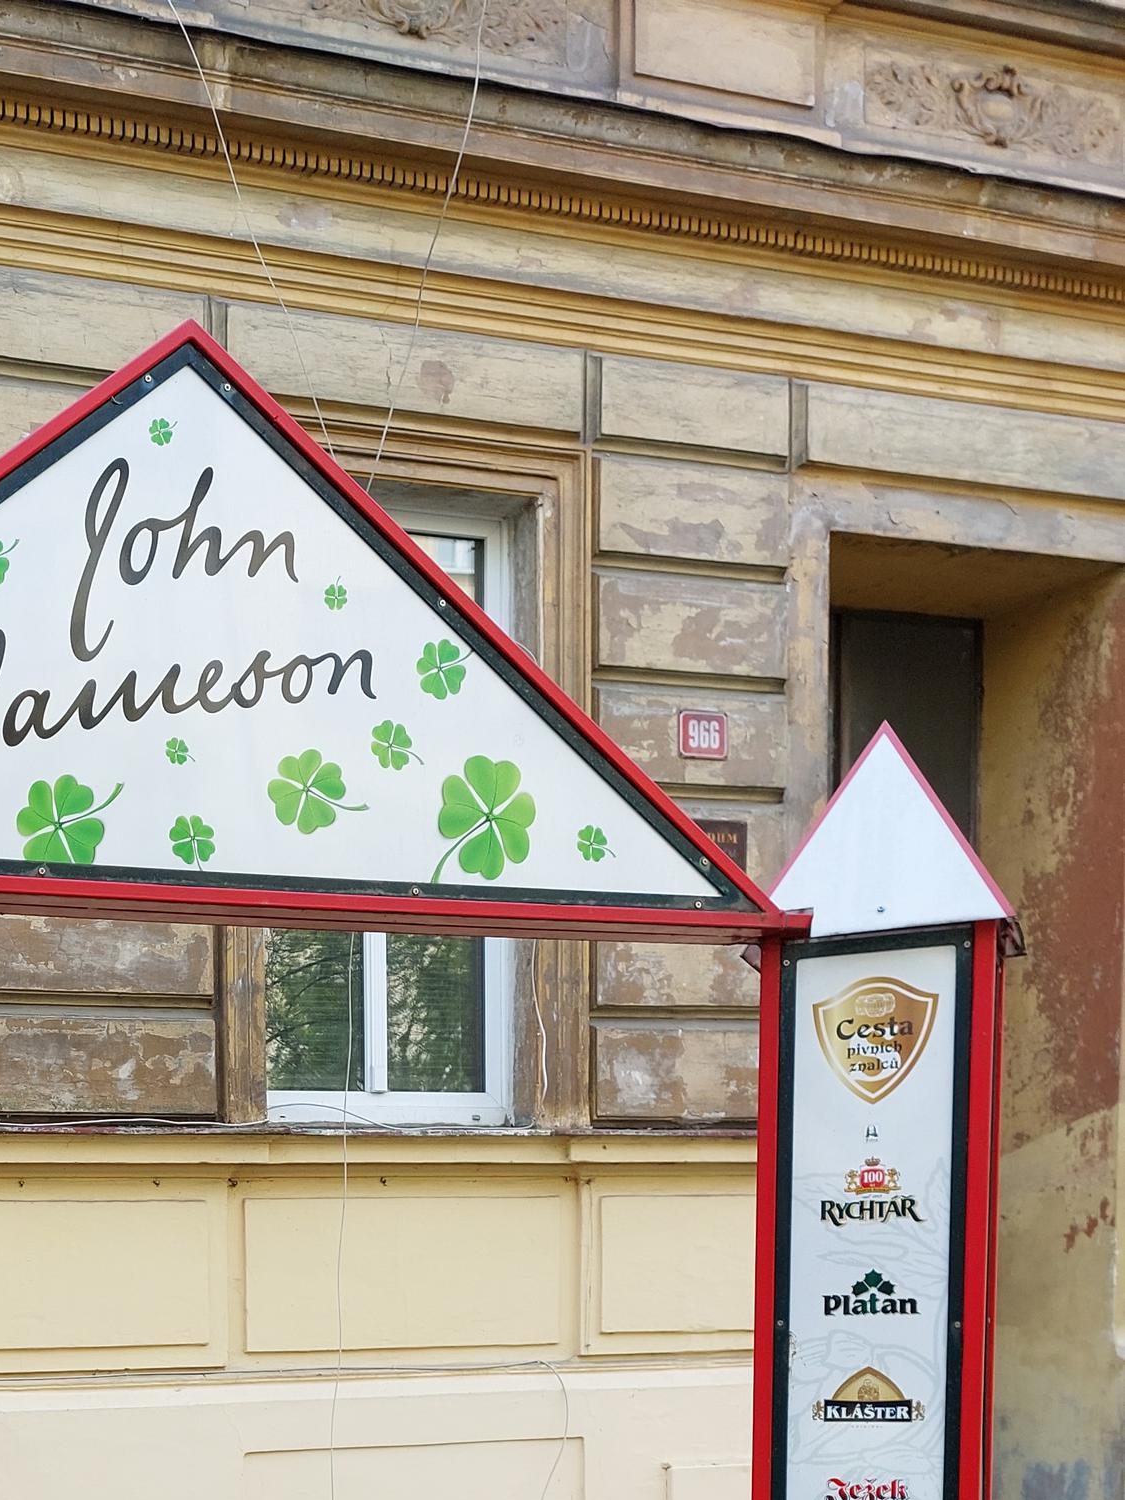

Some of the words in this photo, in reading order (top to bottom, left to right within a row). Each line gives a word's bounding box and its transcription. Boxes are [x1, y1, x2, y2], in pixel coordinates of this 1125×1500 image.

[69, 457, 299, 662] John
[688, 719, 720, 749] 966
[836, 1016, 914, 1040] Cesta
[846, 1041, 902, 1059] pivních
[863, 1171, 883, 1183] 100
[820, 1195, 928, 1227] RYCHTÁŘ
[822, 1295, 921, 1317] Platan
[826, 1403, 911, 1420] KLÁŠTER
